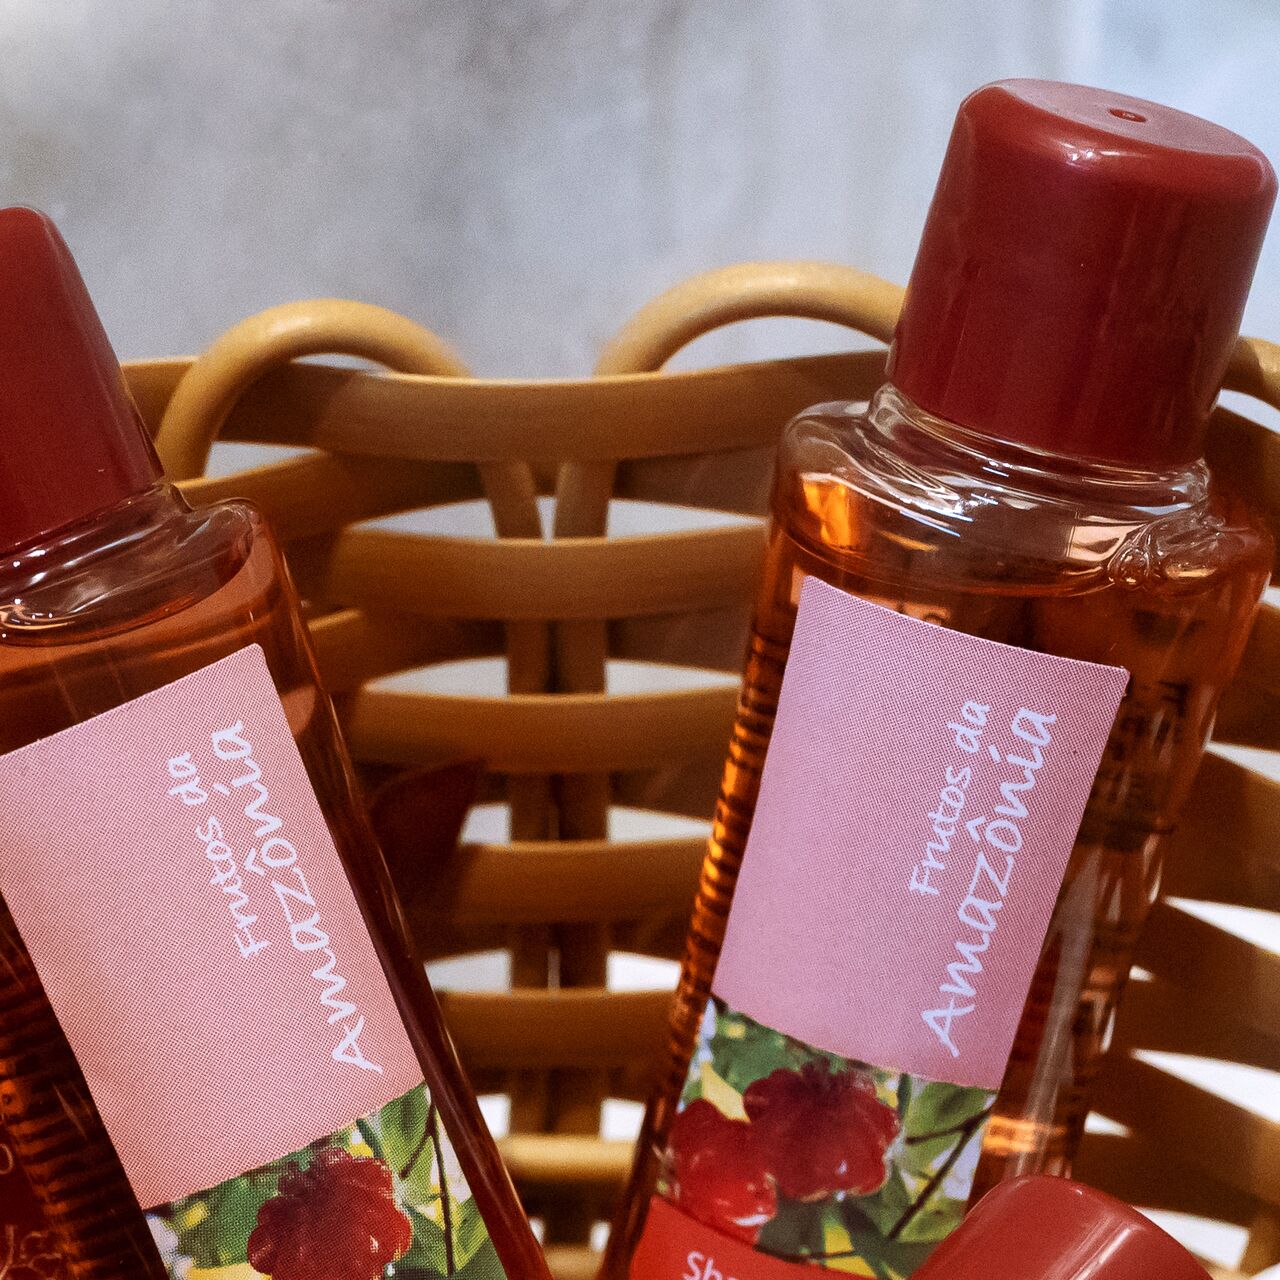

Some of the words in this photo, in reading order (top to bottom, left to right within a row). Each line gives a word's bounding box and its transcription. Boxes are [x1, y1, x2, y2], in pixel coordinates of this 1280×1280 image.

[167, 750, 209, 806] da
[908, 764, 973, 897] Frutos
[946, 699, 992, 755] da
[195, 814, 271, 960] Frutos
[210, 719, 384, 1074] Amazônia
[921, 706, 1059, 1059] Amazônia
